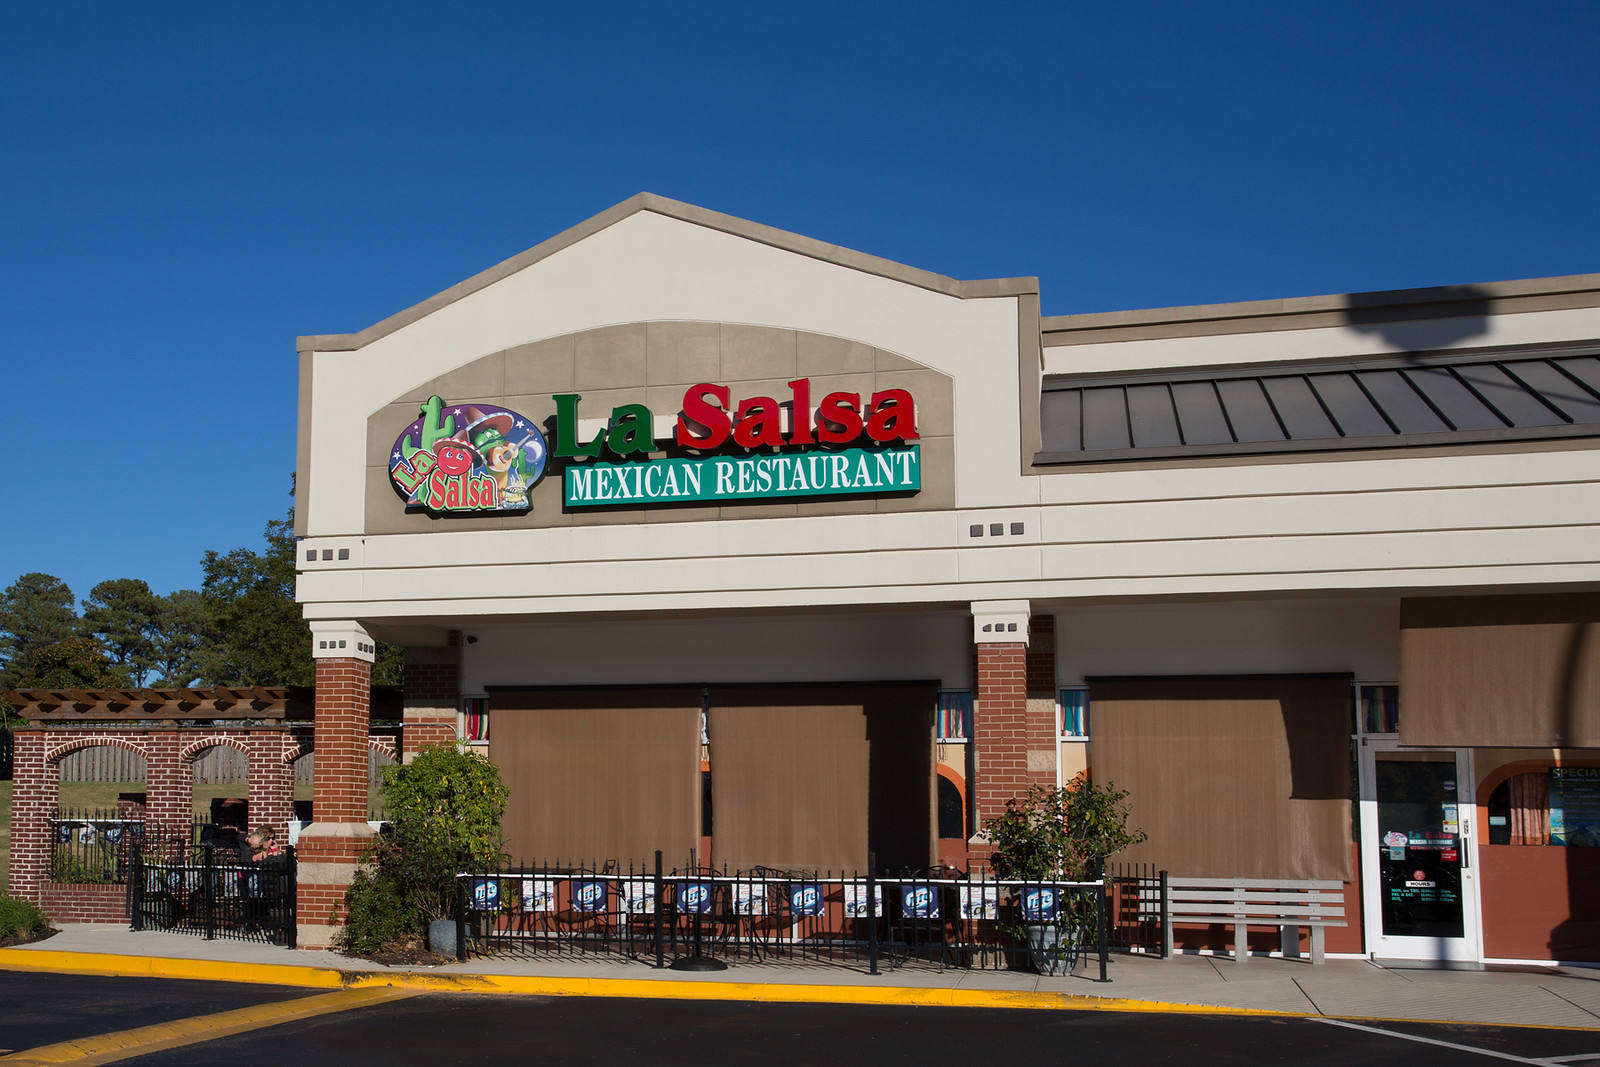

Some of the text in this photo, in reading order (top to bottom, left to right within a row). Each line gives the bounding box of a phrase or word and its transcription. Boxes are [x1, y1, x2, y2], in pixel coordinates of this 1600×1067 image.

[552, 378, 920, 457] La Salsa
[392, 450, 436, 493] La
[428, 469, 494, 509] Salsa
[570, 451, 916, 500] MEXICAN RESTAURANT
